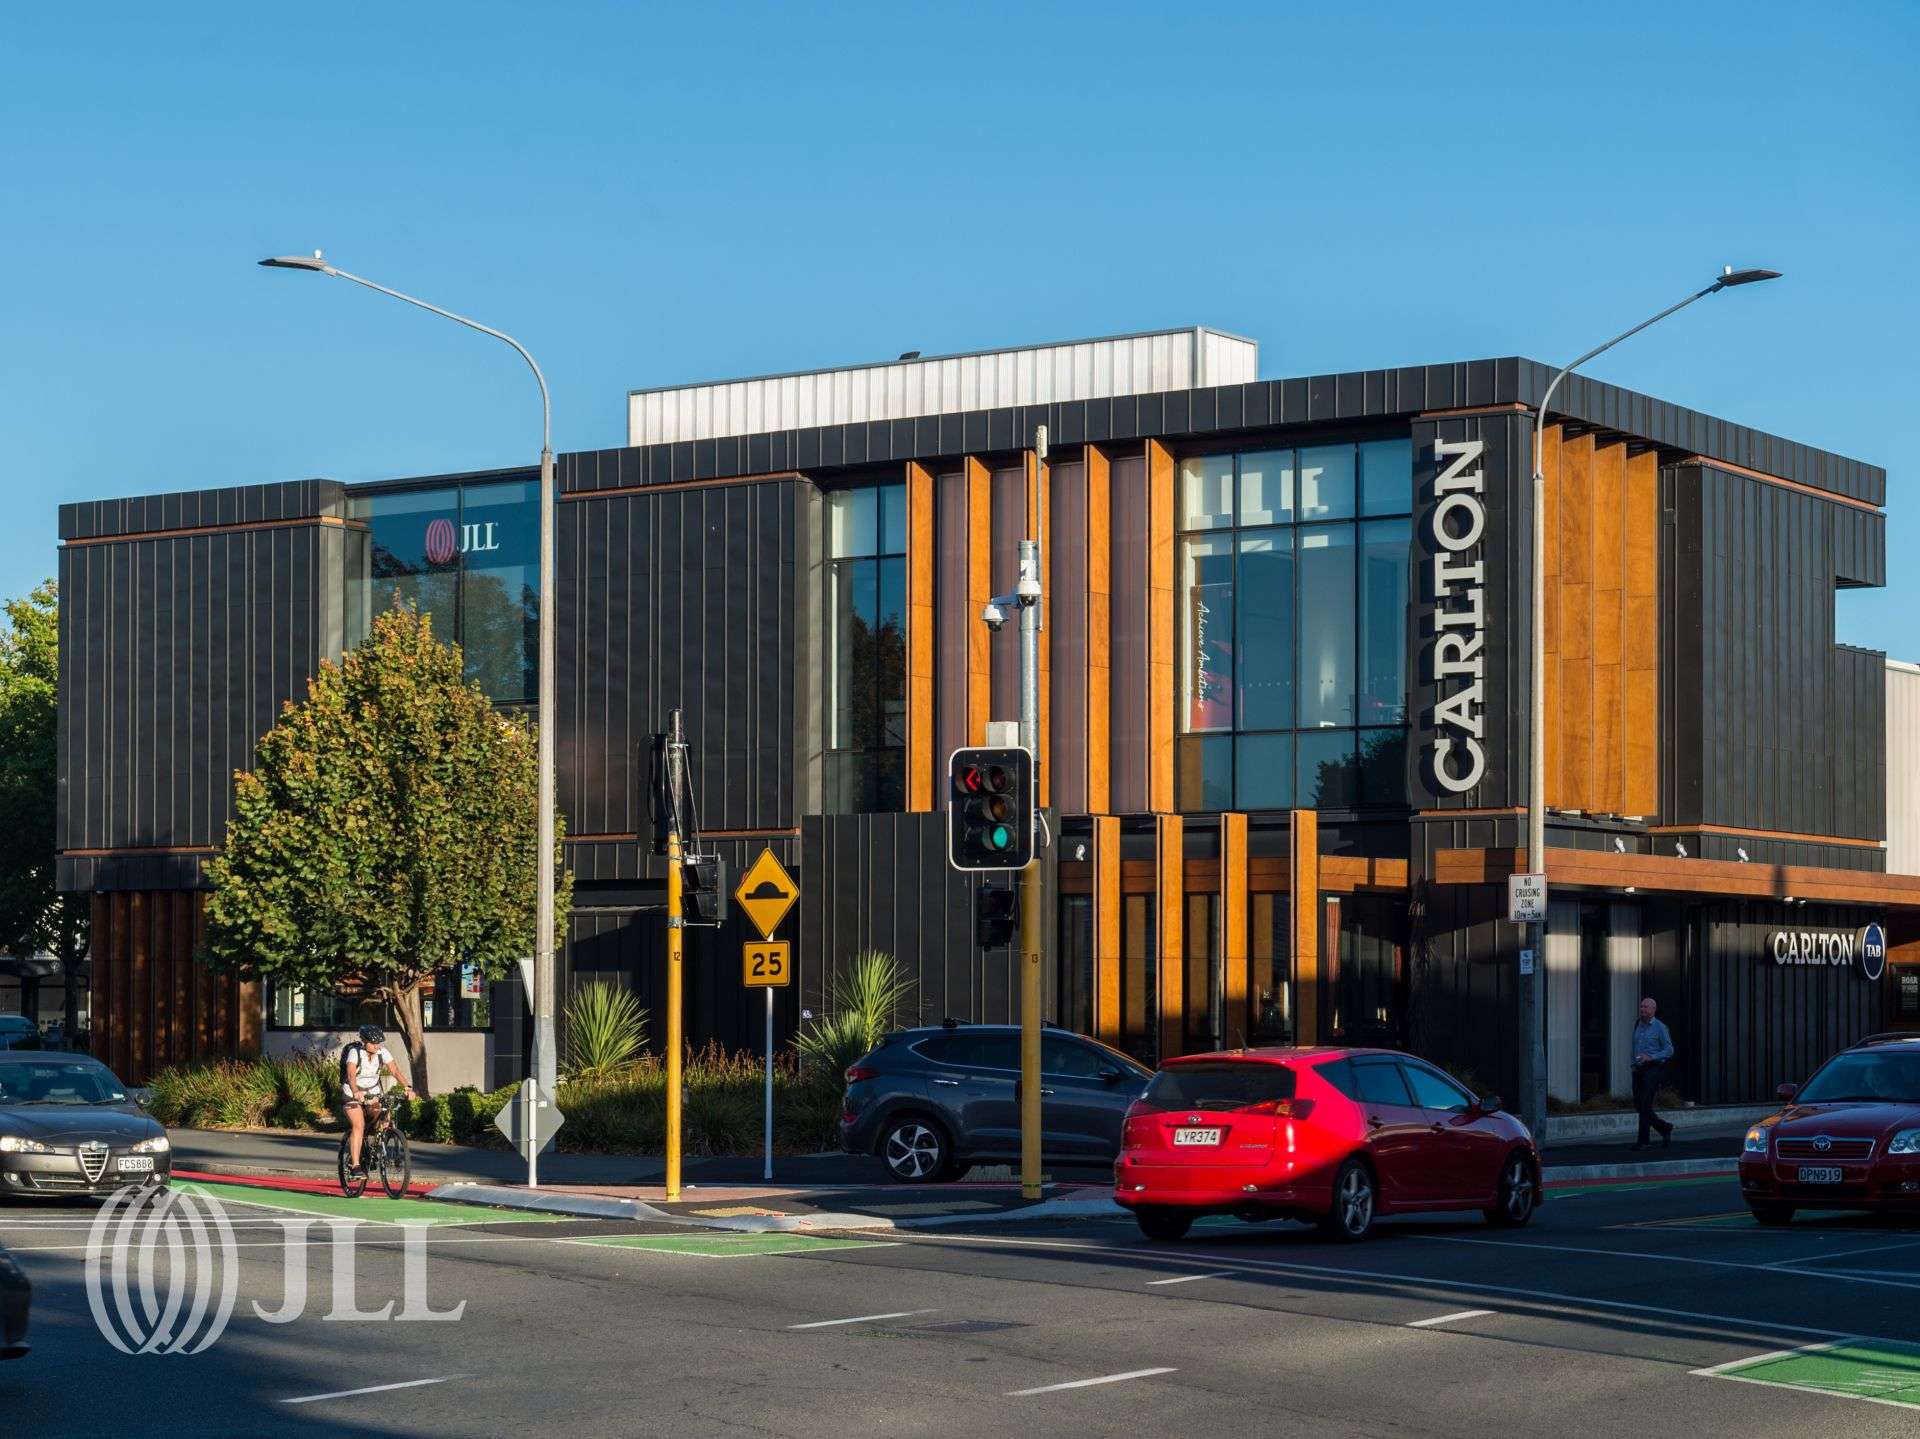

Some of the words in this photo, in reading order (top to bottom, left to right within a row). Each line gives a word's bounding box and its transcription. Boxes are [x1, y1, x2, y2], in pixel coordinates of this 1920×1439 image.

[457, 522, 500, 553] JLL
[1197, 600, 1210, 648] Achieve
[1433, 438, 1484, 792] CARLTON
[1197, 650, 1210, 712] Ambitions
[1515, 888, 1540, 898] CRUISING
[1524, 877, 1532, 886] NO
[1520, 899, 1535, 909] ZONE
[1774, 931, 1854, 966] CARLTON
[1866, 944, 1881, 957] TAB
[752, 952, 782, 976] 25
[1176, 1130, 1217, 1143] LYR374
